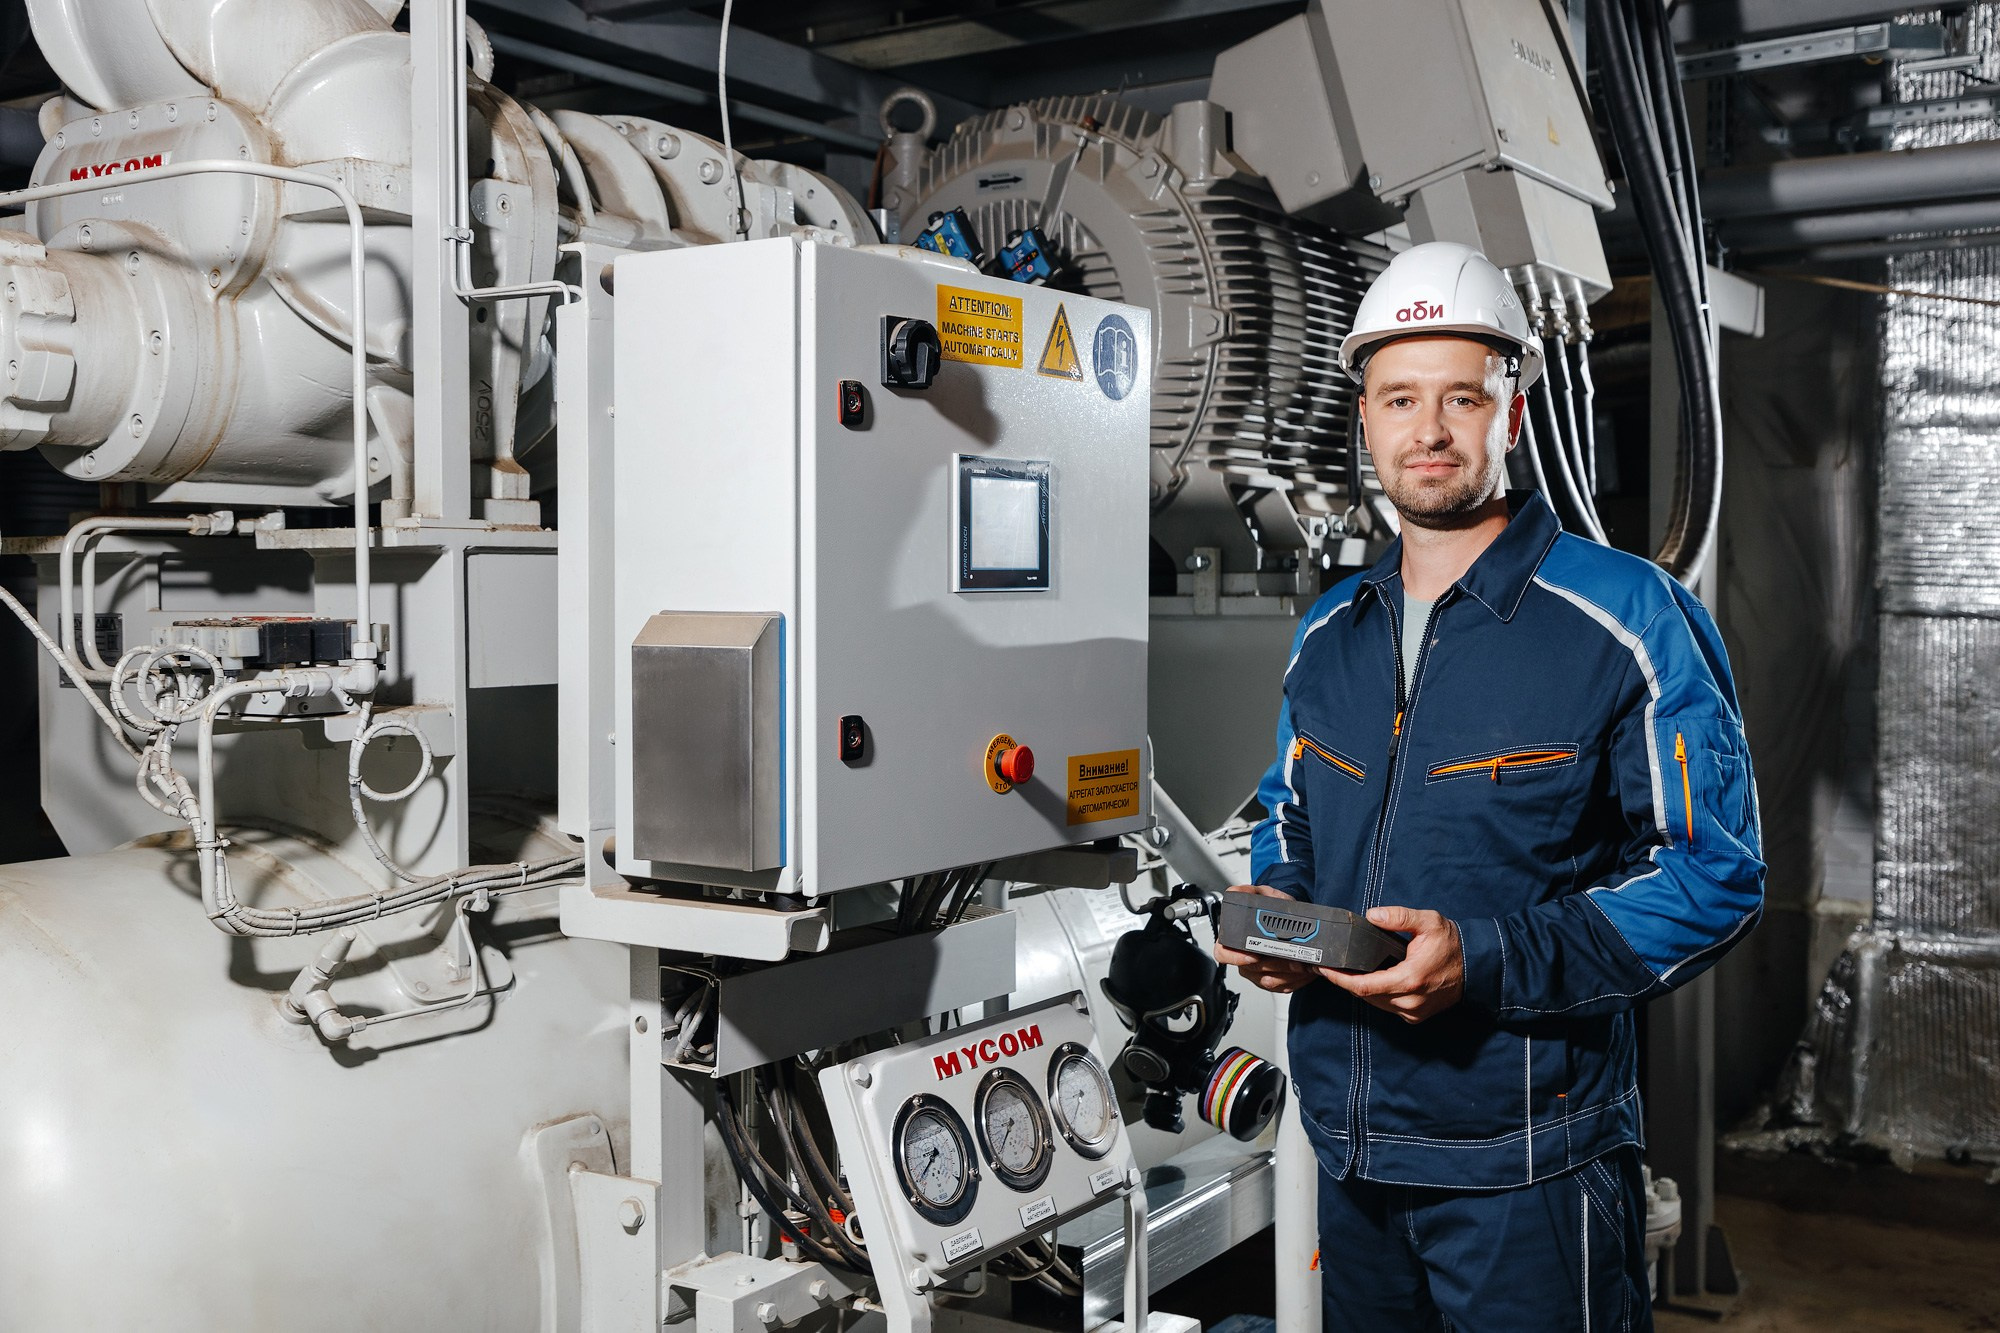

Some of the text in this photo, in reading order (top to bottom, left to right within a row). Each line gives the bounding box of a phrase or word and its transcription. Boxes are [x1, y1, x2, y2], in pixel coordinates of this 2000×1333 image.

[70, 154, 163, 182] MYCOM
[949, 295, 1013, 318] ATTENTION:
[1395, 300, 1444, 323] аби
[941, 321, 1020, 344] MACHINE STARTS
[943, 339, 1019, 360] AUTOMATICALLY
[987, 736, 1016, 760] EMERGENC
[1079, 759, 1129, 778] Внимание!
[1069, 781, 1138, 800] АГРЕГАТ ЗАПУСКАЕТСЯ
[1077, 798, 1130, 815] АВТОМАТИЧЕСКИ
[932, 1024, 1044, 1081] MYCOM
